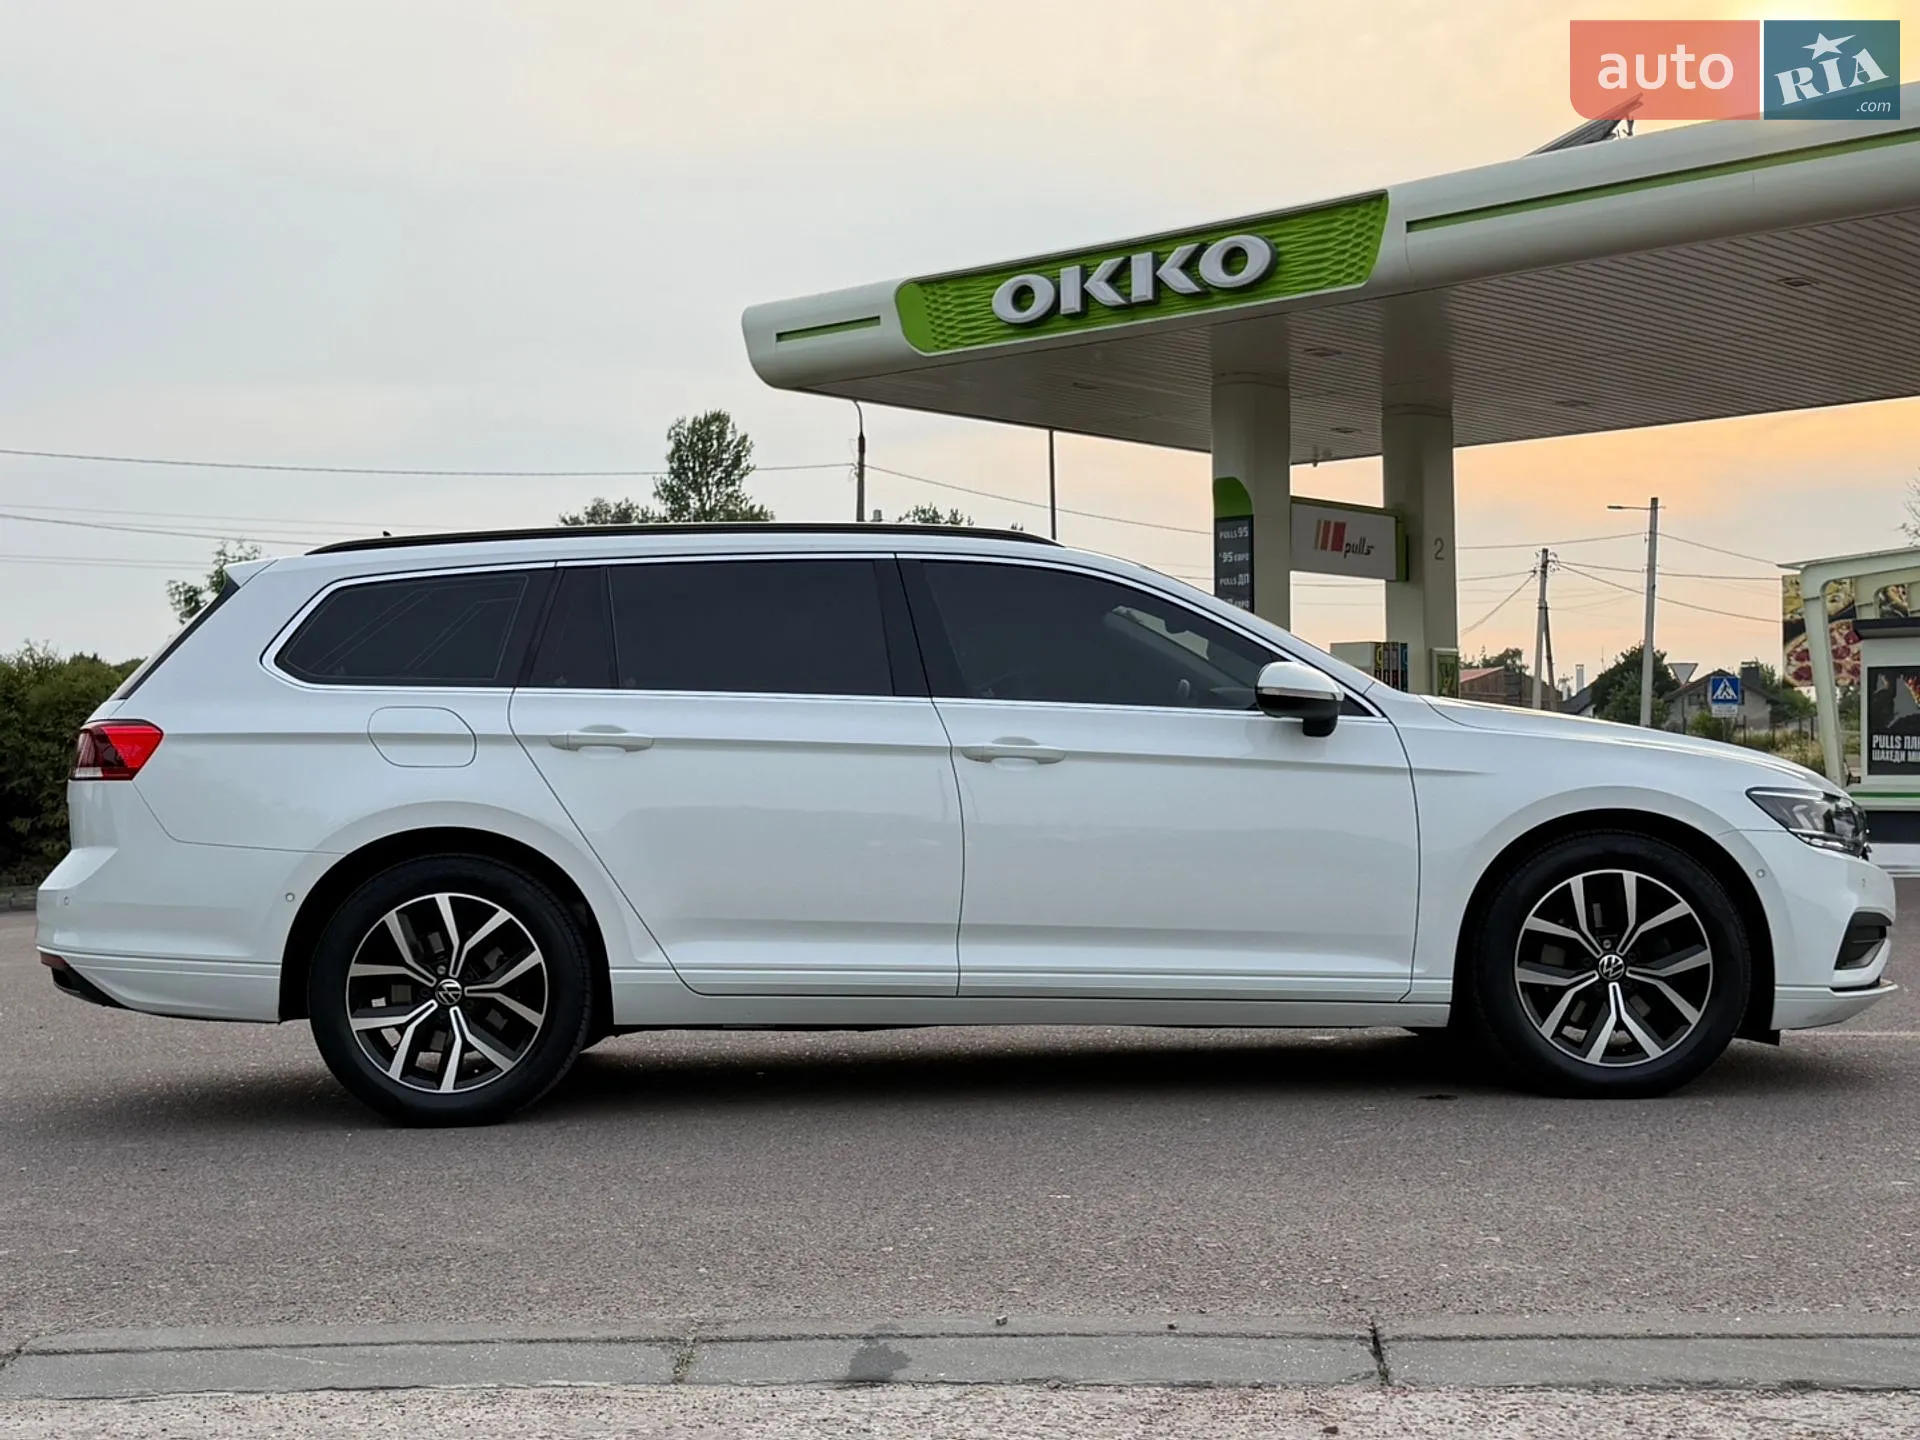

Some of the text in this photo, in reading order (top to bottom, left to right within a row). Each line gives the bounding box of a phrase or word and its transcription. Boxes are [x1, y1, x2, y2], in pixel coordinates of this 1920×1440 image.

[992, 234, 1273, 324] OKKO
[1237, 526, 1249, 538] 95
[1344, 536, 1375, 559] pulls
[1434, 537, 1445, 560] 2
[1872, 734, 1902, 749] PULLS
